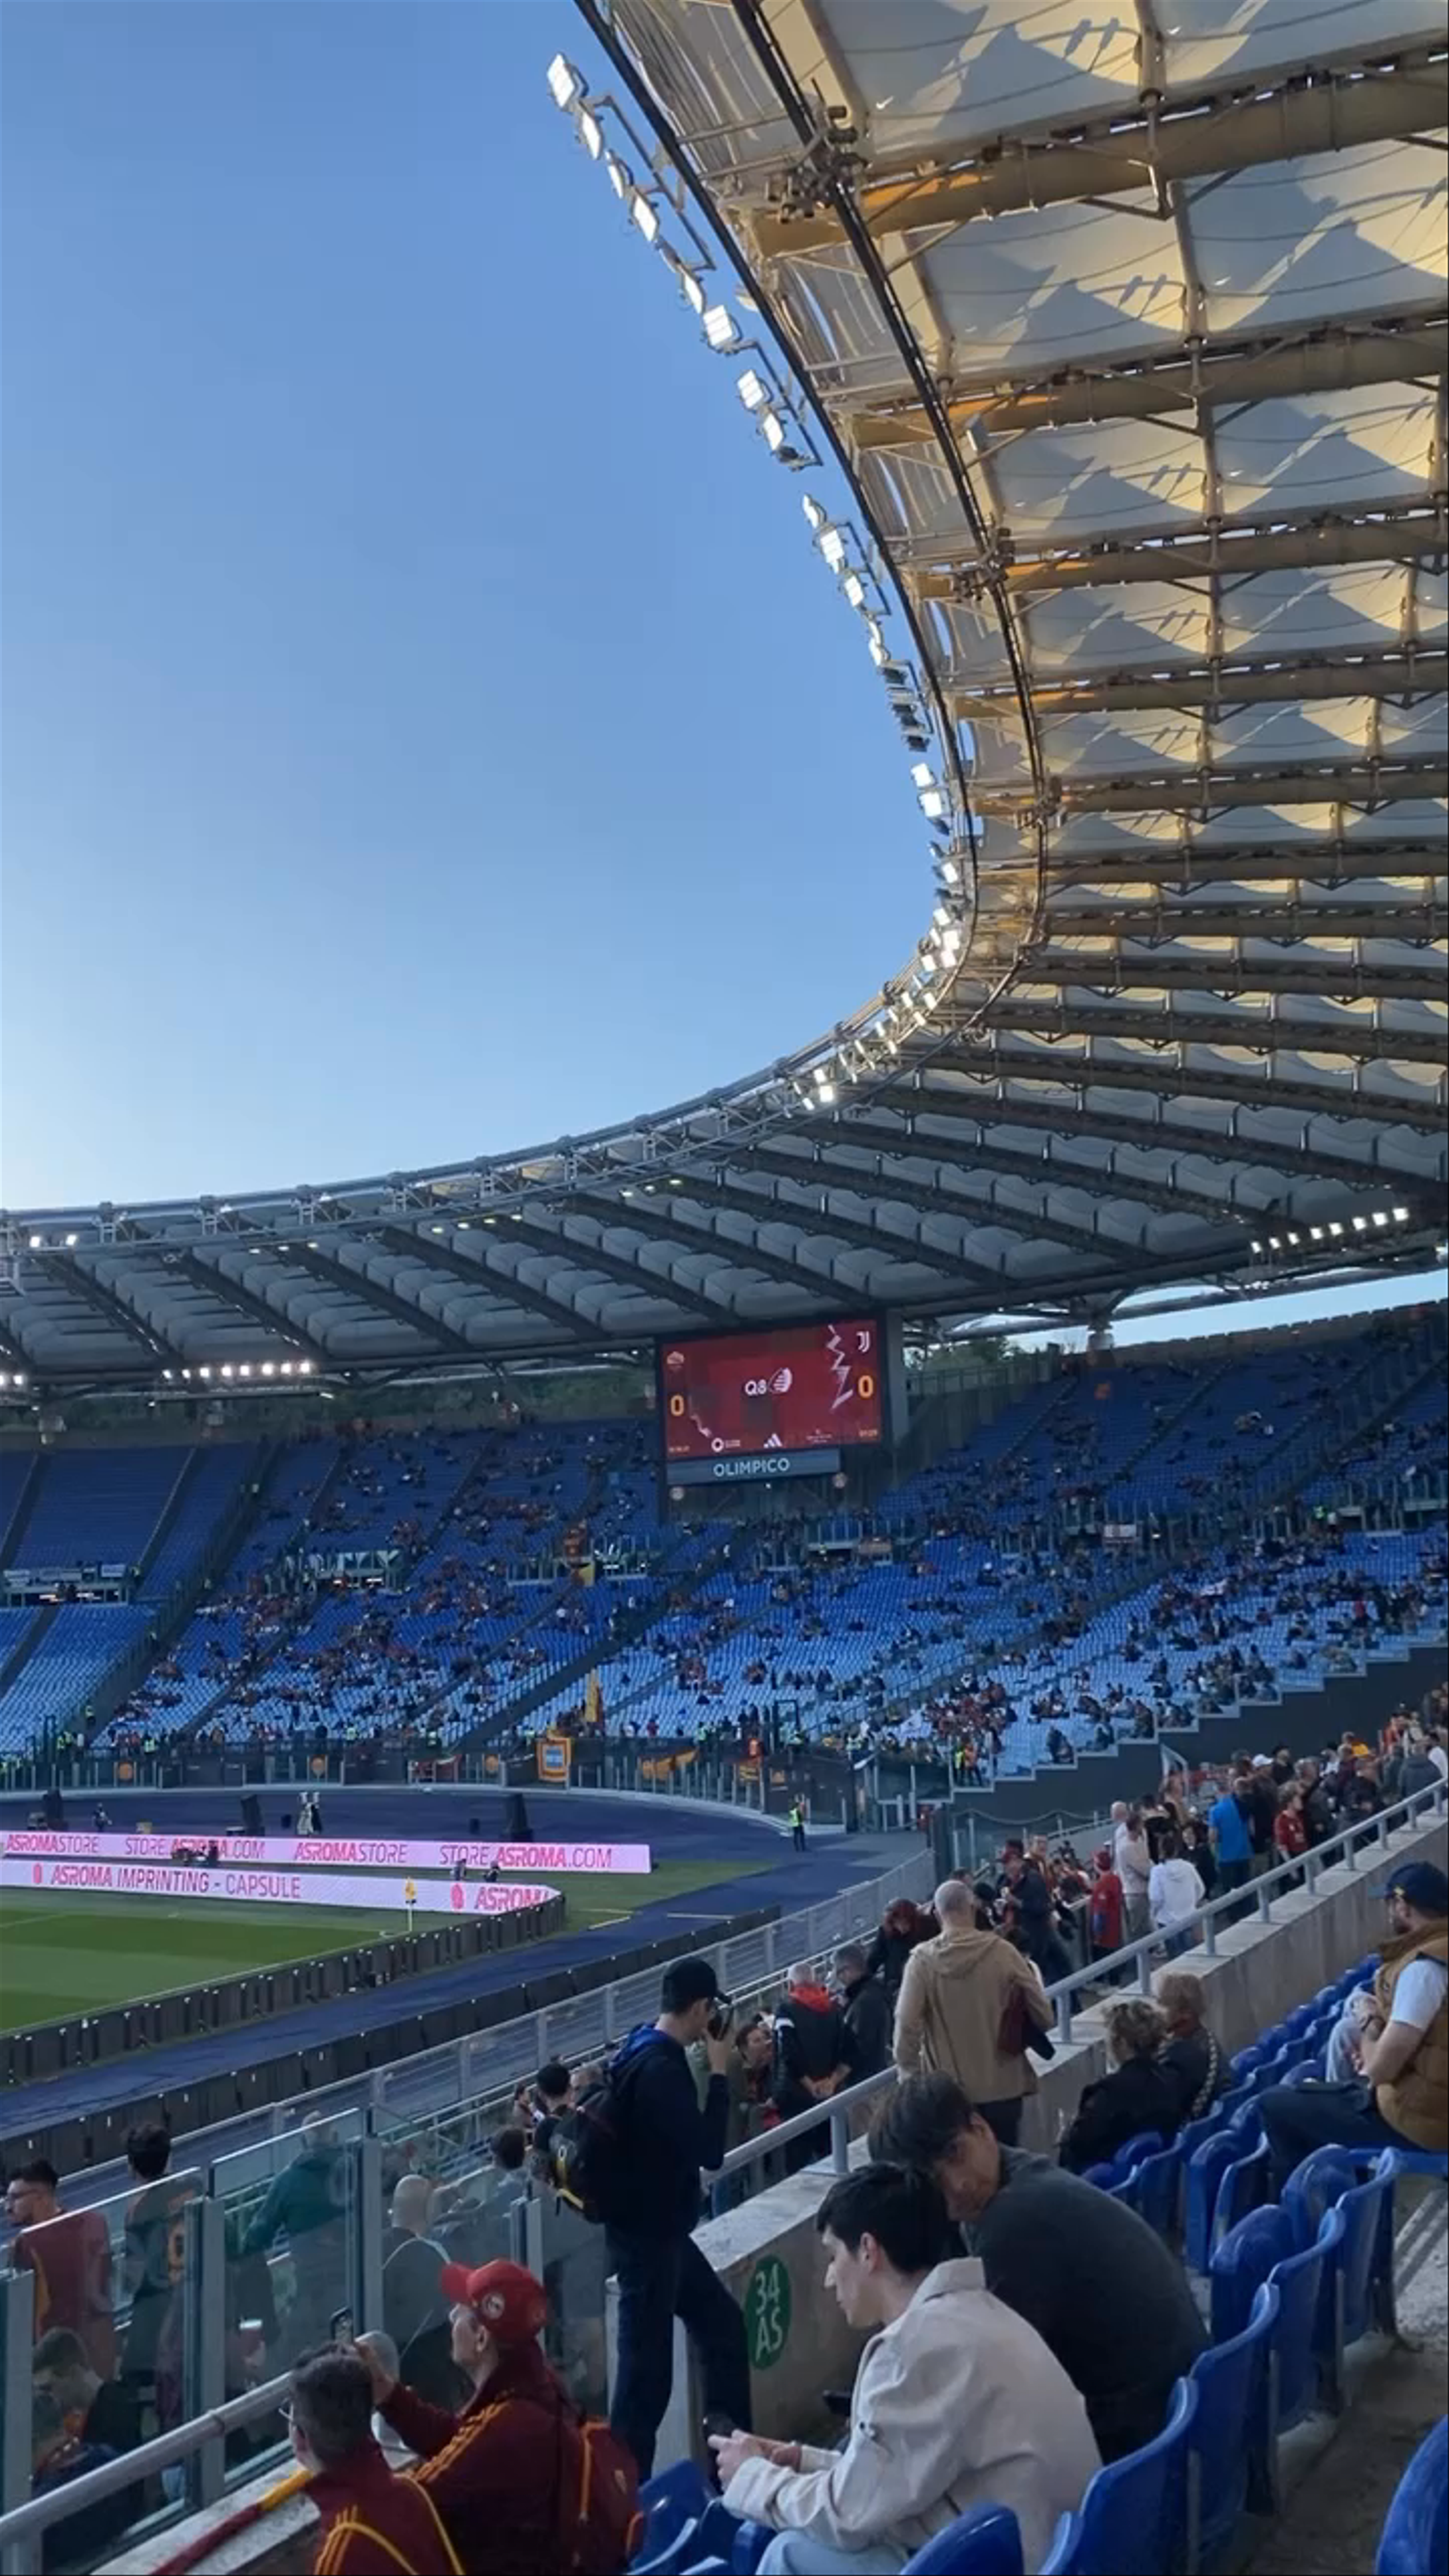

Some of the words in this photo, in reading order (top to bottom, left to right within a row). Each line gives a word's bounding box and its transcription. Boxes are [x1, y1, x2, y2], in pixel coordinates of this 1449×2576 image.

[744, 1380, 767, 1396] Q8
[858, 1375, 874, 1398] 0
[671, 1395, 684, 1416] 0
[713, 1458, 790, 1477] OLIMPICO
[294, 1842, 408, 1863] ASROMASTORE
[51, 1864, 112, 1886] ASROMA
[117, 1867, 209, 1893] IMPRINTING
[226, 1874, 301, 1899] CAPSULE
[755, 2263, 780, 2315] 34
[755, 2306, 783, 2361] AS
